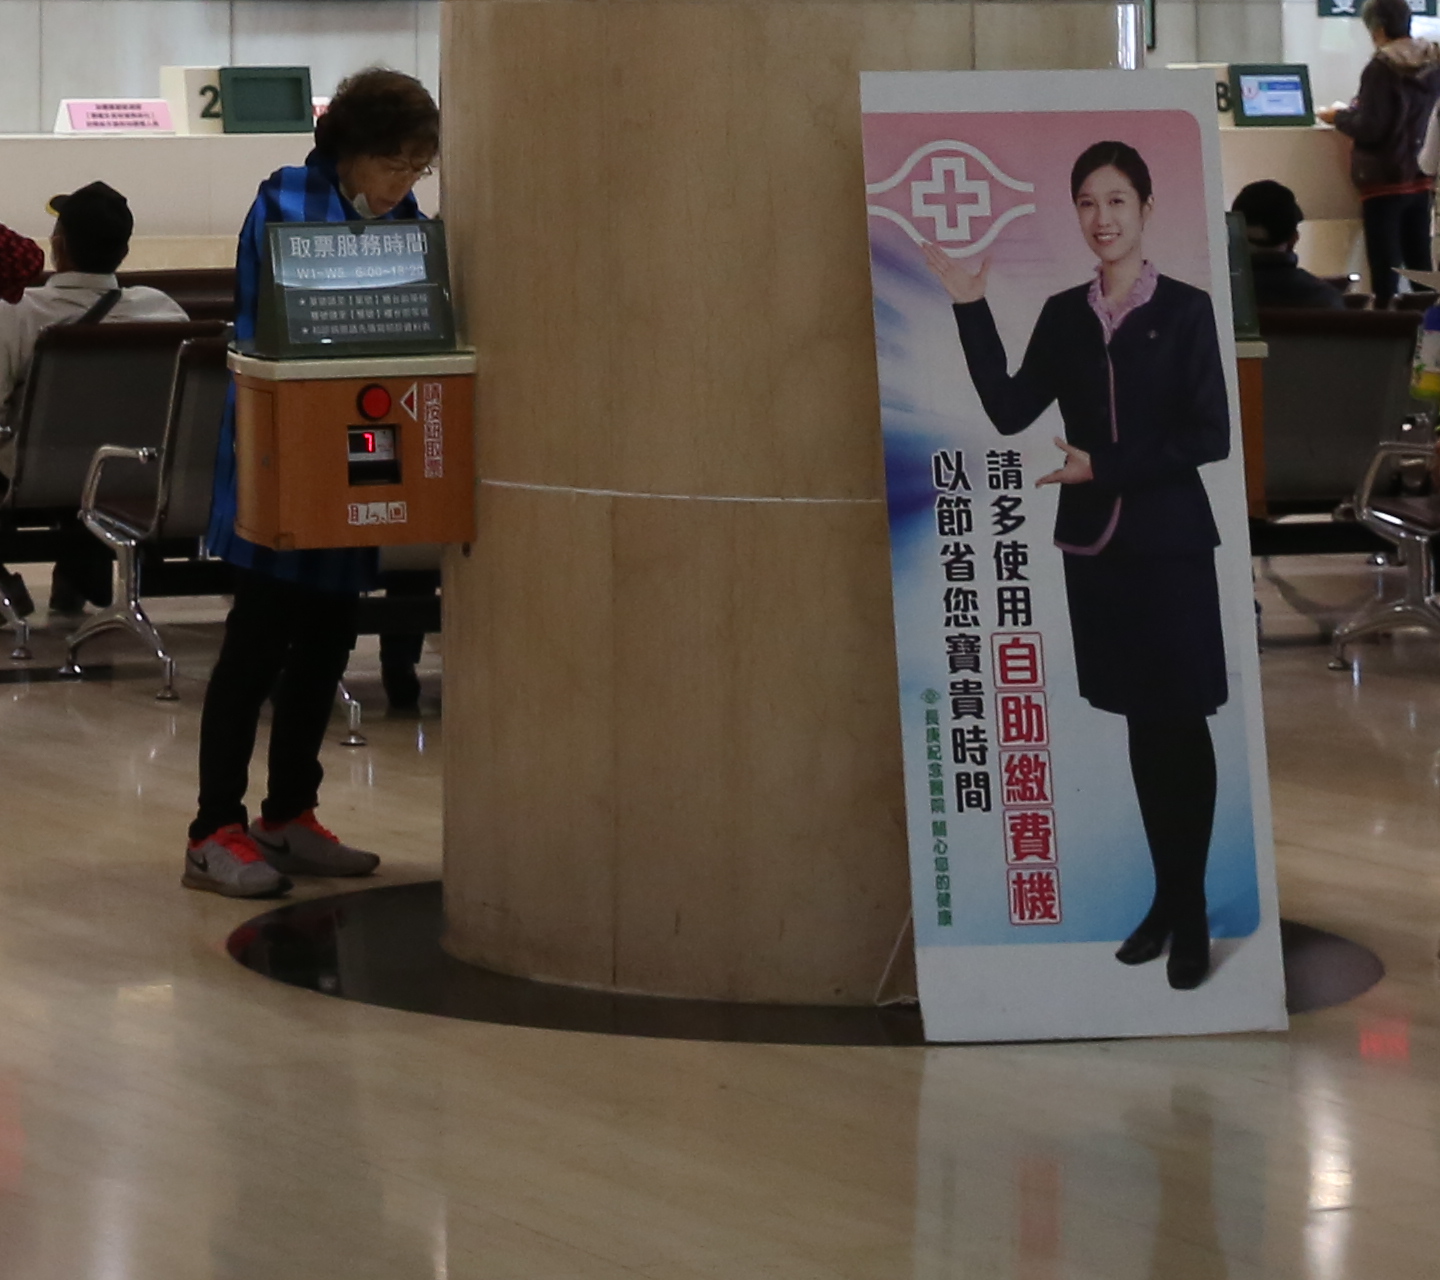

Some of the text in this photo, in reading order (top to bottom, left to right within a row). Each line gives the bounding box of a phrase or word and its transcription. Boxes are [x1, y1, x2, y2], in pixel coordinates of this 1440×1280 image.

[199, 85, 221, 119] 2
[289, 232, 428, 258] 取票服務時間
[932, 450, 992, 813] 以節省您寶貴時間
[986, 449, 1058, 922] 請多使用自助繳費機
